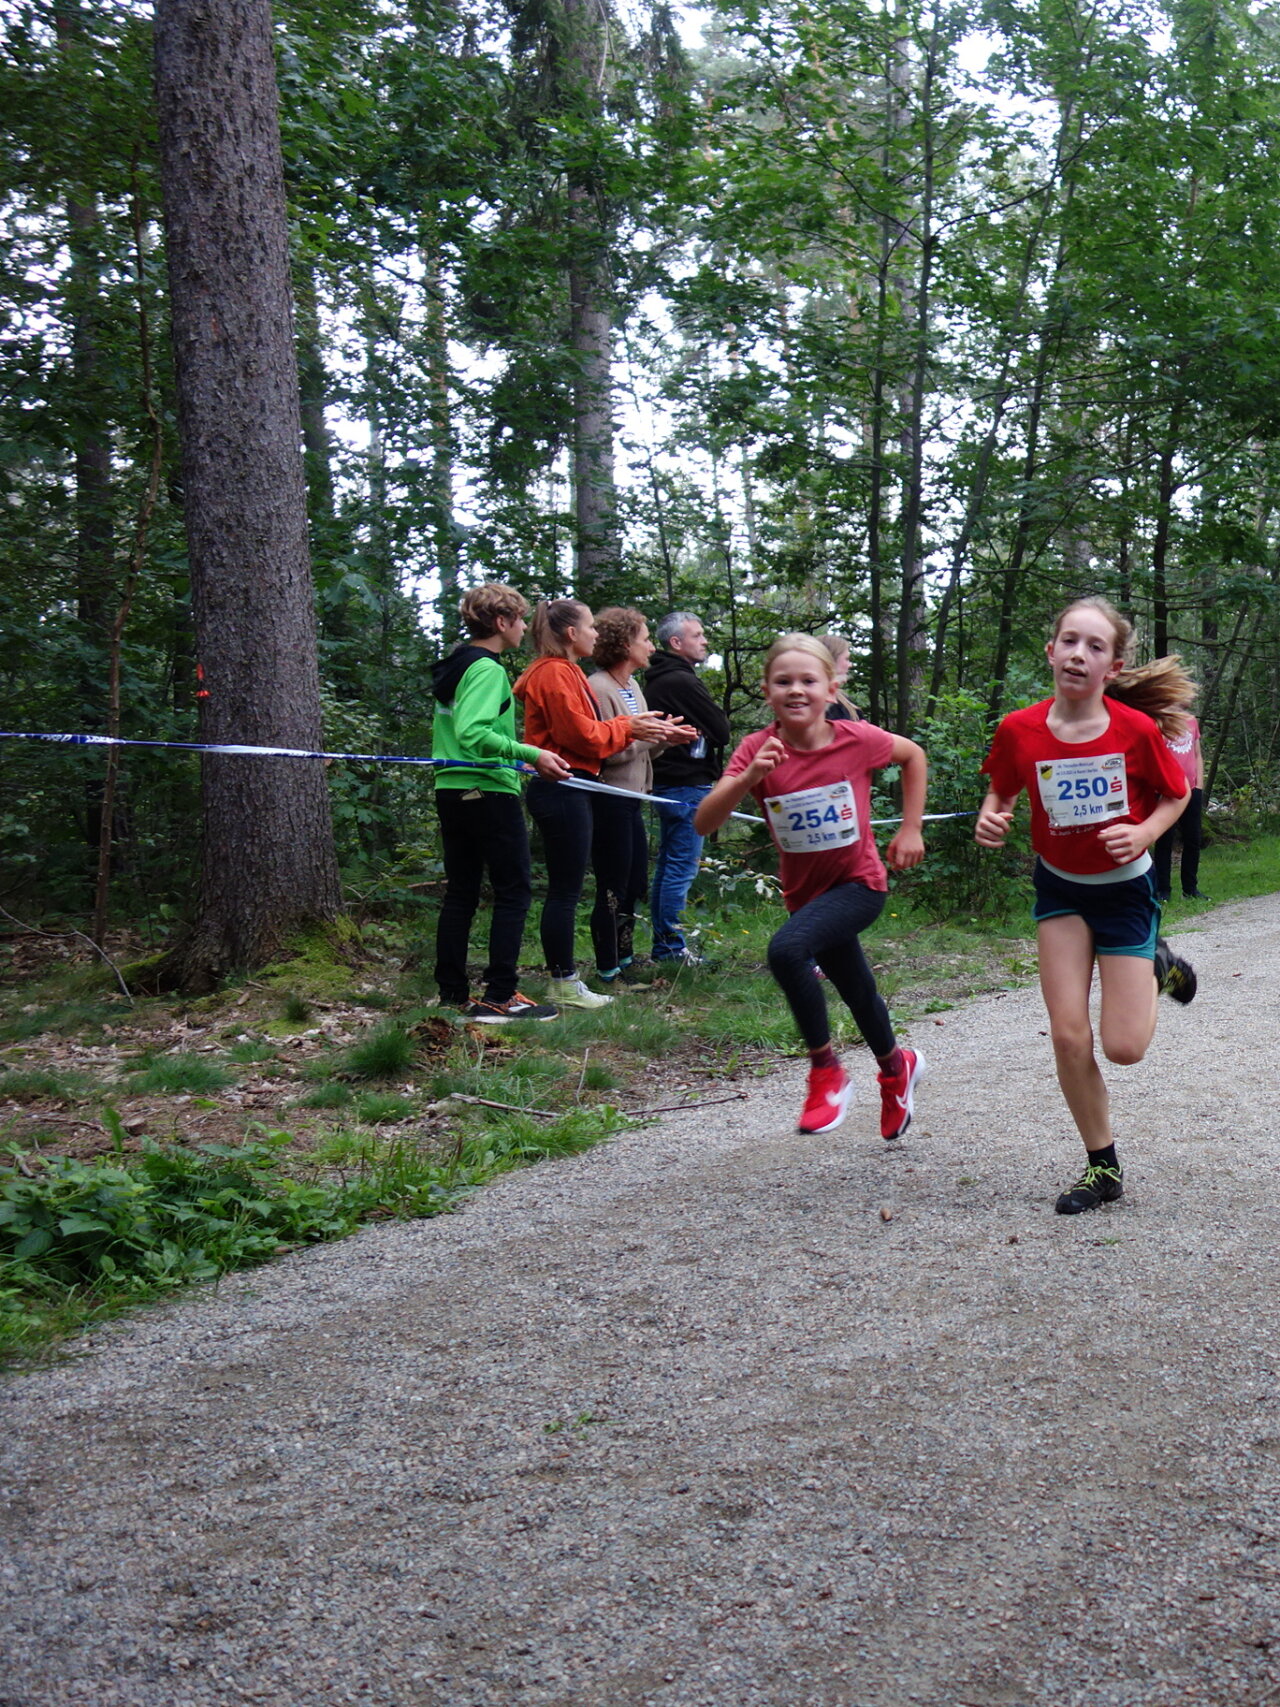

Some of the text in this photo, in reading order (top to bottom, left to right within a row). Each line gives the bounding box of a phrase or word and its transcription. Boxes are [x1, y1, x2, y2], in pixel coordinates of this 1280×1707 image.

[1057, 776, 1109, 800] 250
[788, 804, 840, 832] 254
[1073, 804, 1087, 817] 2,5
[1089, 803, 1104, 815] km
[807, 832, 822, 845] 2,5
[822, 831, 837, 841] km
